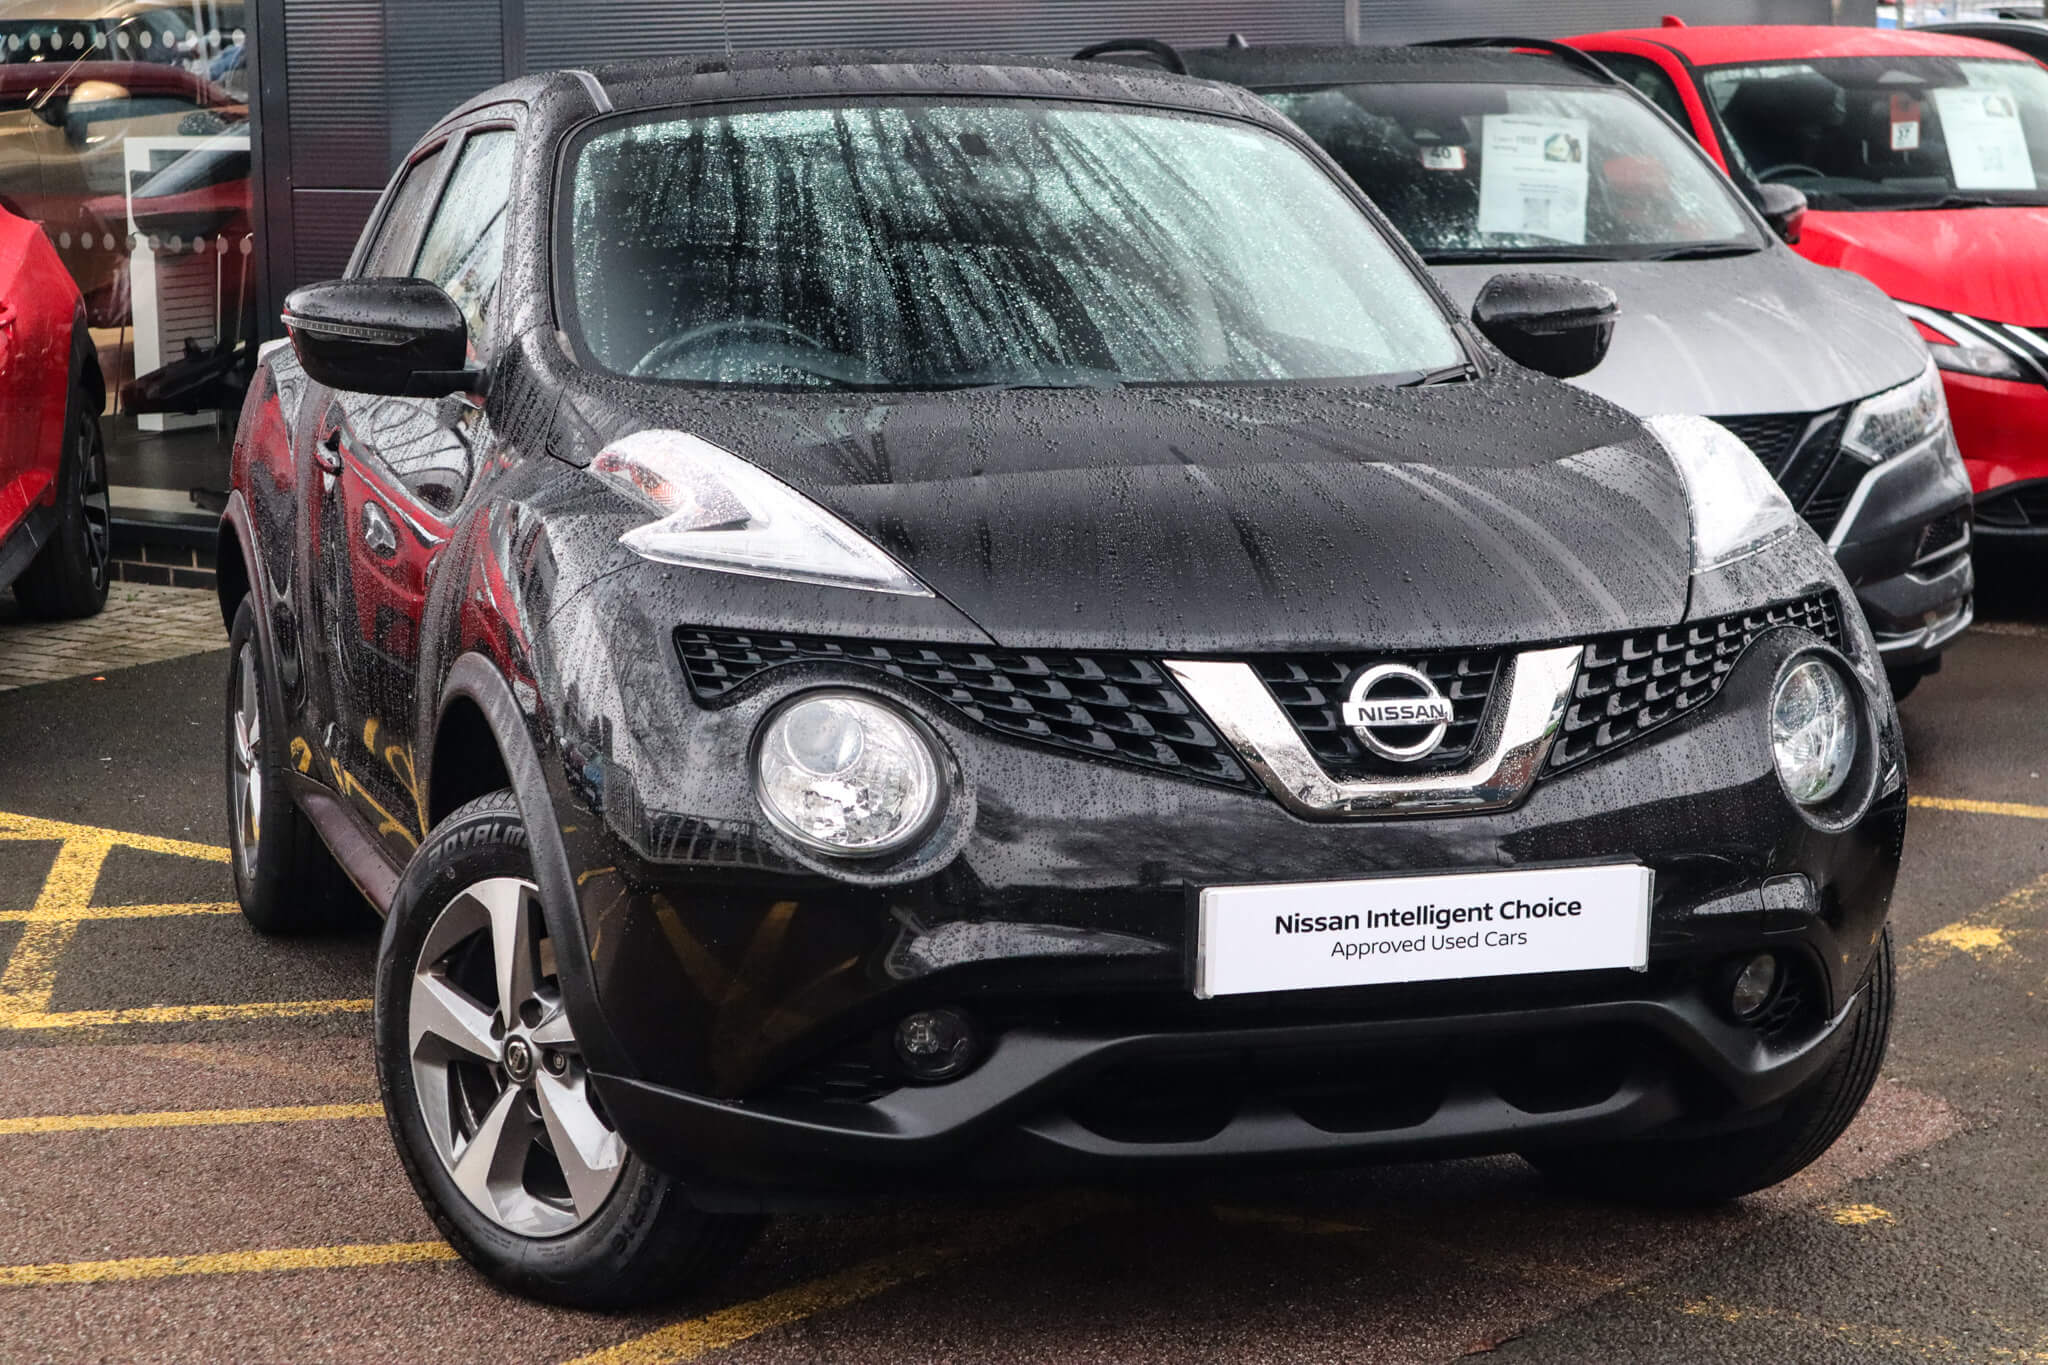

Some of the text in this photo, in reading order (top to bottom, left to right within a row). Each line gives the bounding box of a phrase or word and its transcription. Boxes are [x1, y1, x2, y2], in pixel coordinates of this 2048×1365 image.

[1358, 704, 1444, 721] NISSAN
[1275, 897, 1582, 935] Nissan Intelligent Choice
[1331, 929, 1528, 960] Approved Used Cars
